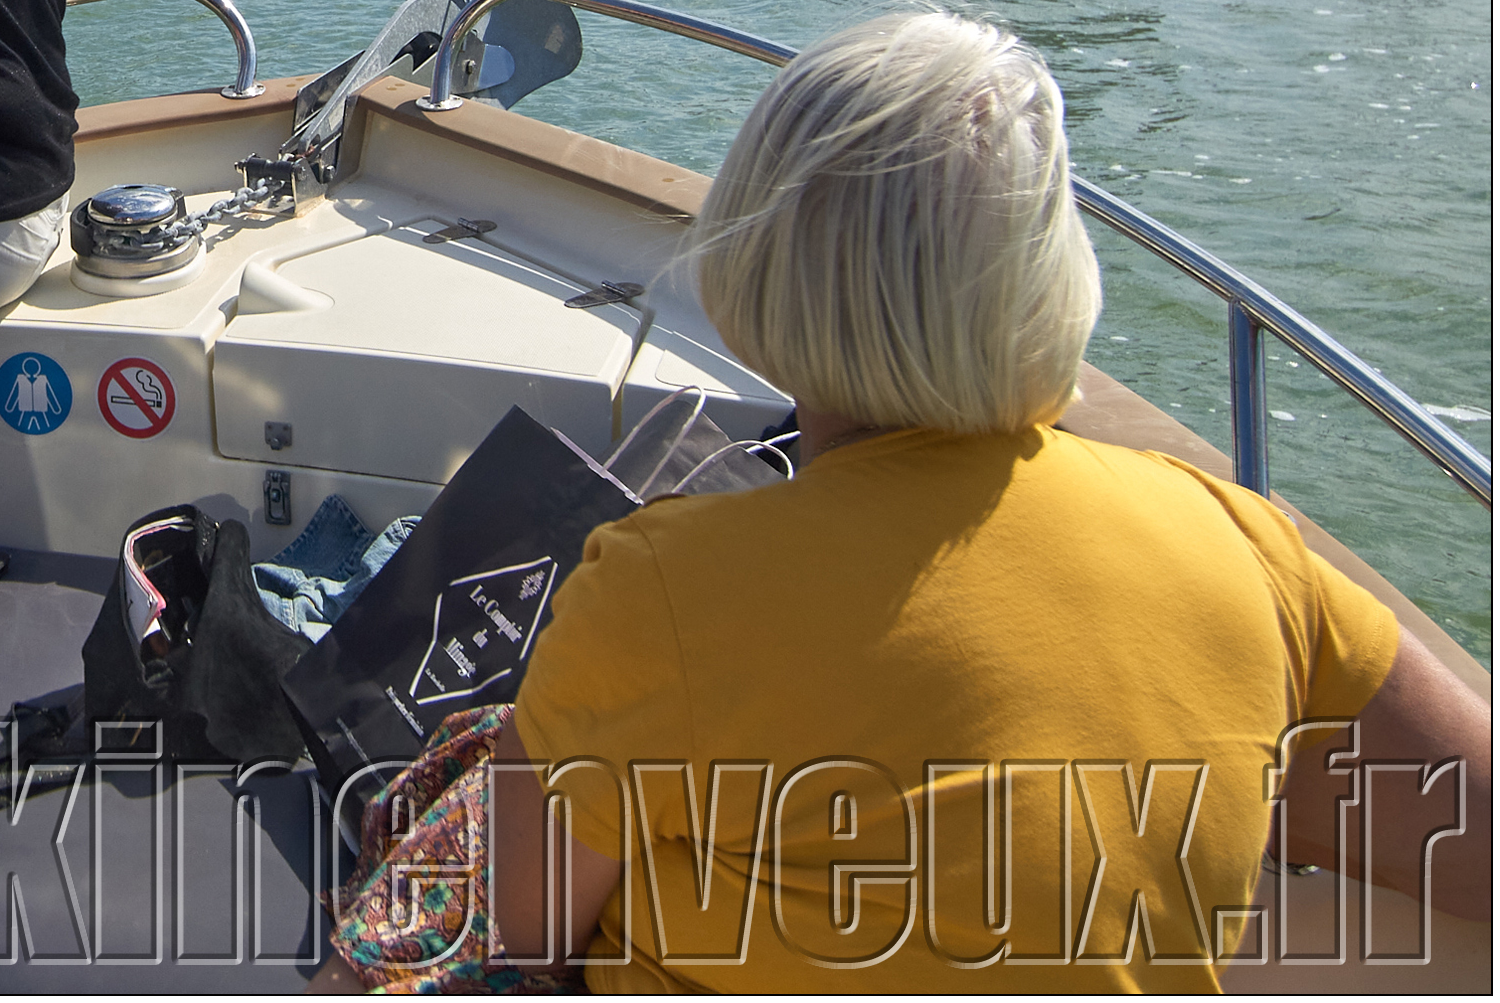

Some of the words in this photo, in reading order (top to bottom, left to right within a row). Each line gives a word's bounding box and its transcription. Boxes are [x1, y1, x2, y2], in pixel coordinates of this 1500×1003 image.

[469, 584, 487, 606] Le
[472, 628, 489, 649] du
[443, 637, 477, 679] Minage
